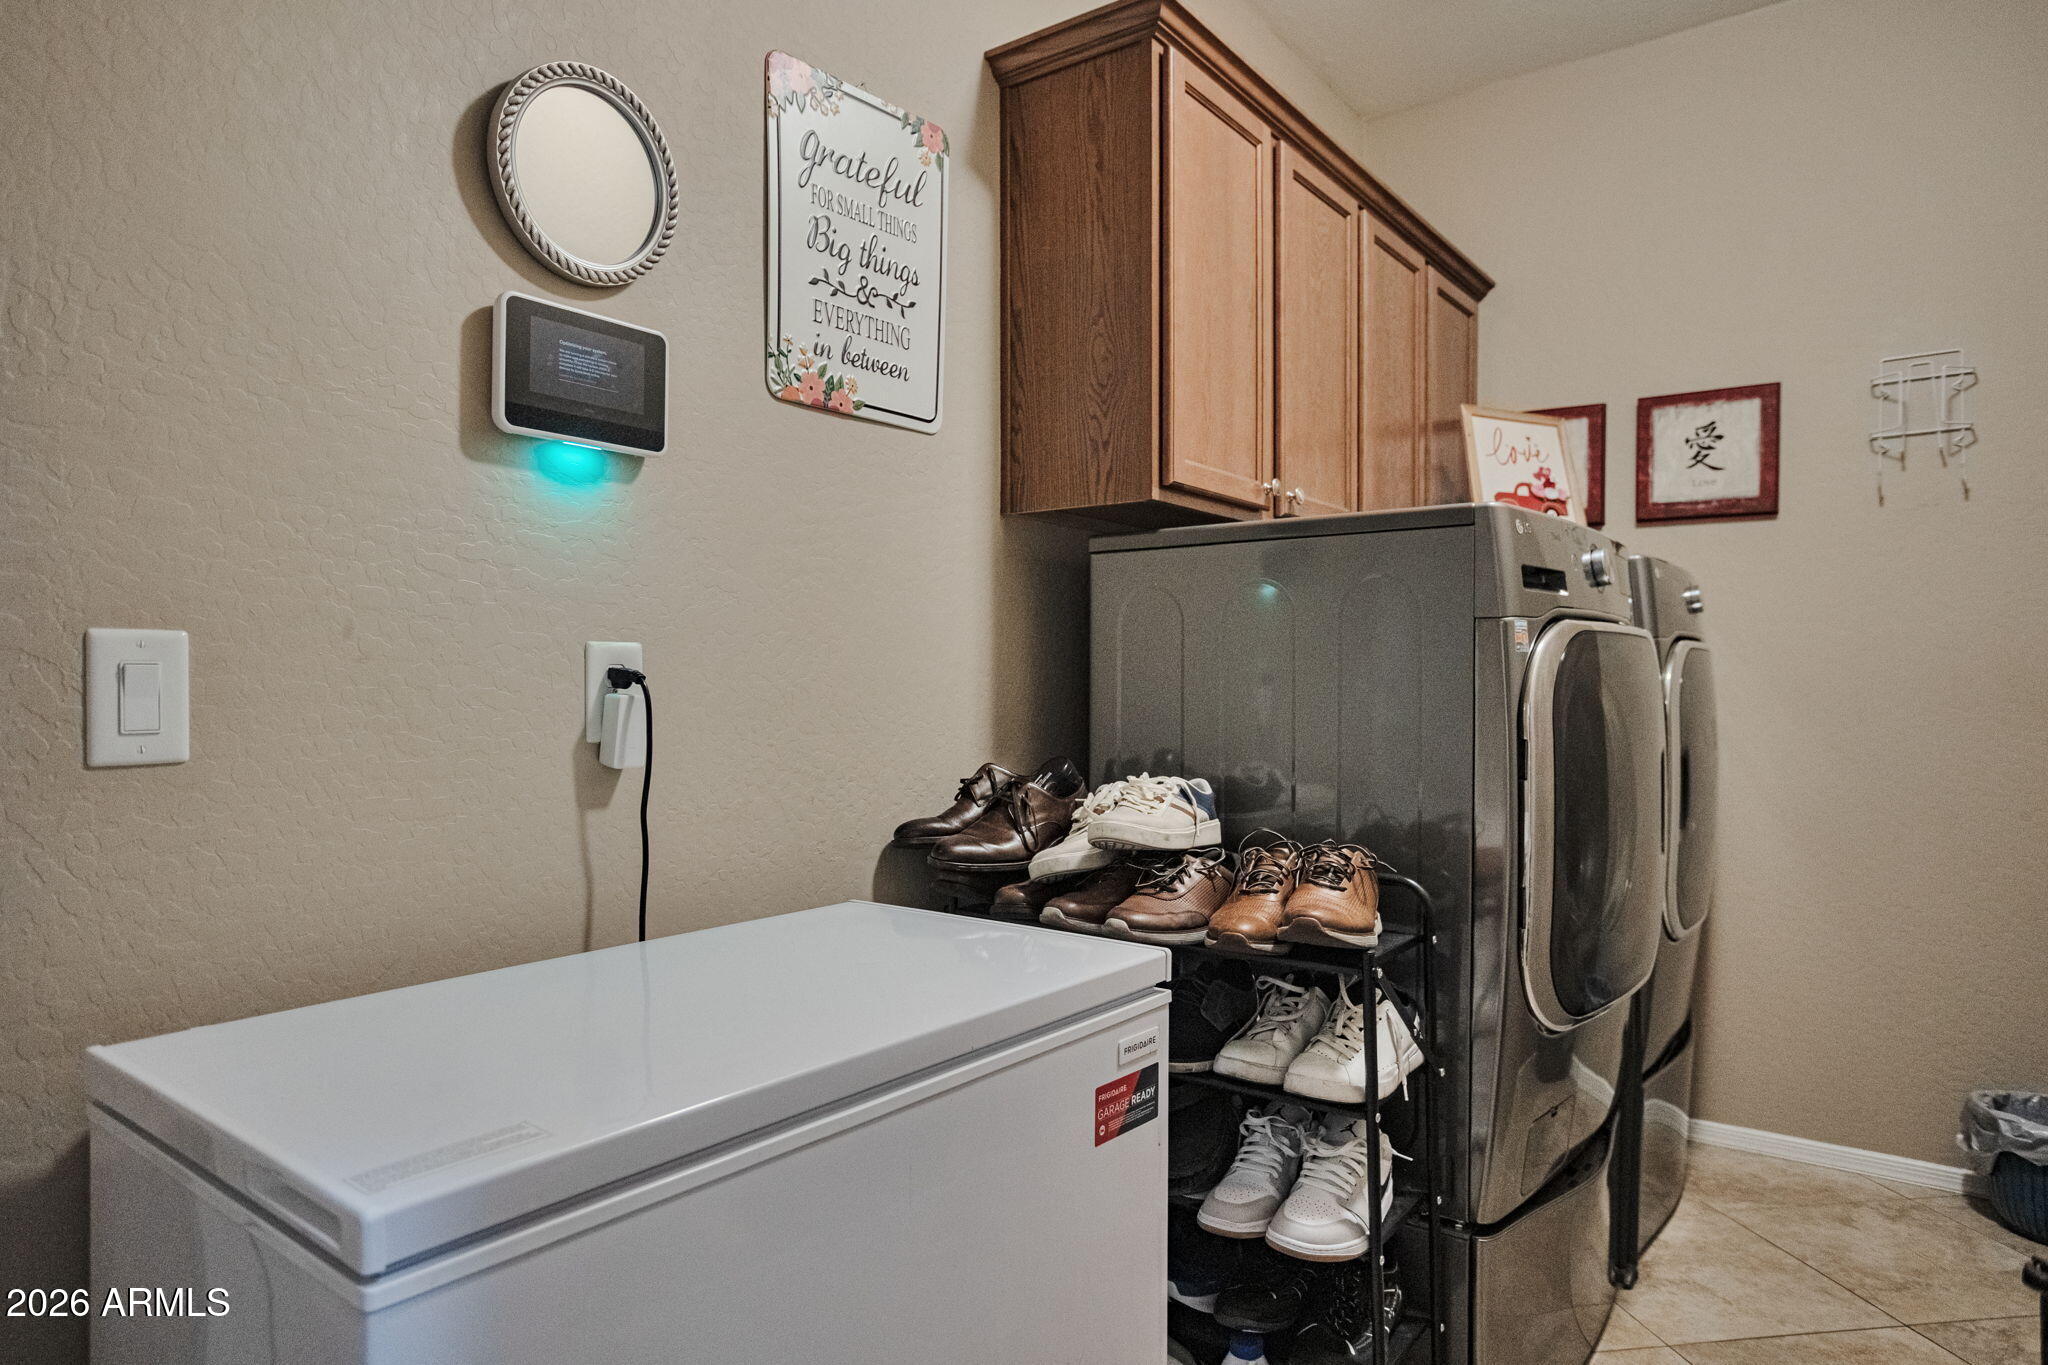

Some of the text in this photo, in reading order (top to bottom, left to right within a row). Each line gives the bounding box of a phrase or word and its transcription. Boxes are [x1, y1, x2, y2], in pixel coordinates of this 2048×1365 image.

[811, 183, 918, 244] FOR SMALL THINGS
[807, 215, 920, 297] Big things
[856, 276, 878, 309] &
[813, 299, 911, 350] EVERYTHING
[813, 333, 910, 382] in between
[1685, 421, 1725, 471] 愛
[1123, 1035, 1157, 1056] FRIGIDAIRE
[1097, 1097, 1130, 1121] GARAGE
[1131, 1085, 1156, 1106] READY
[1098, 1084, 1128, 1103] FRIGIDAIRE
